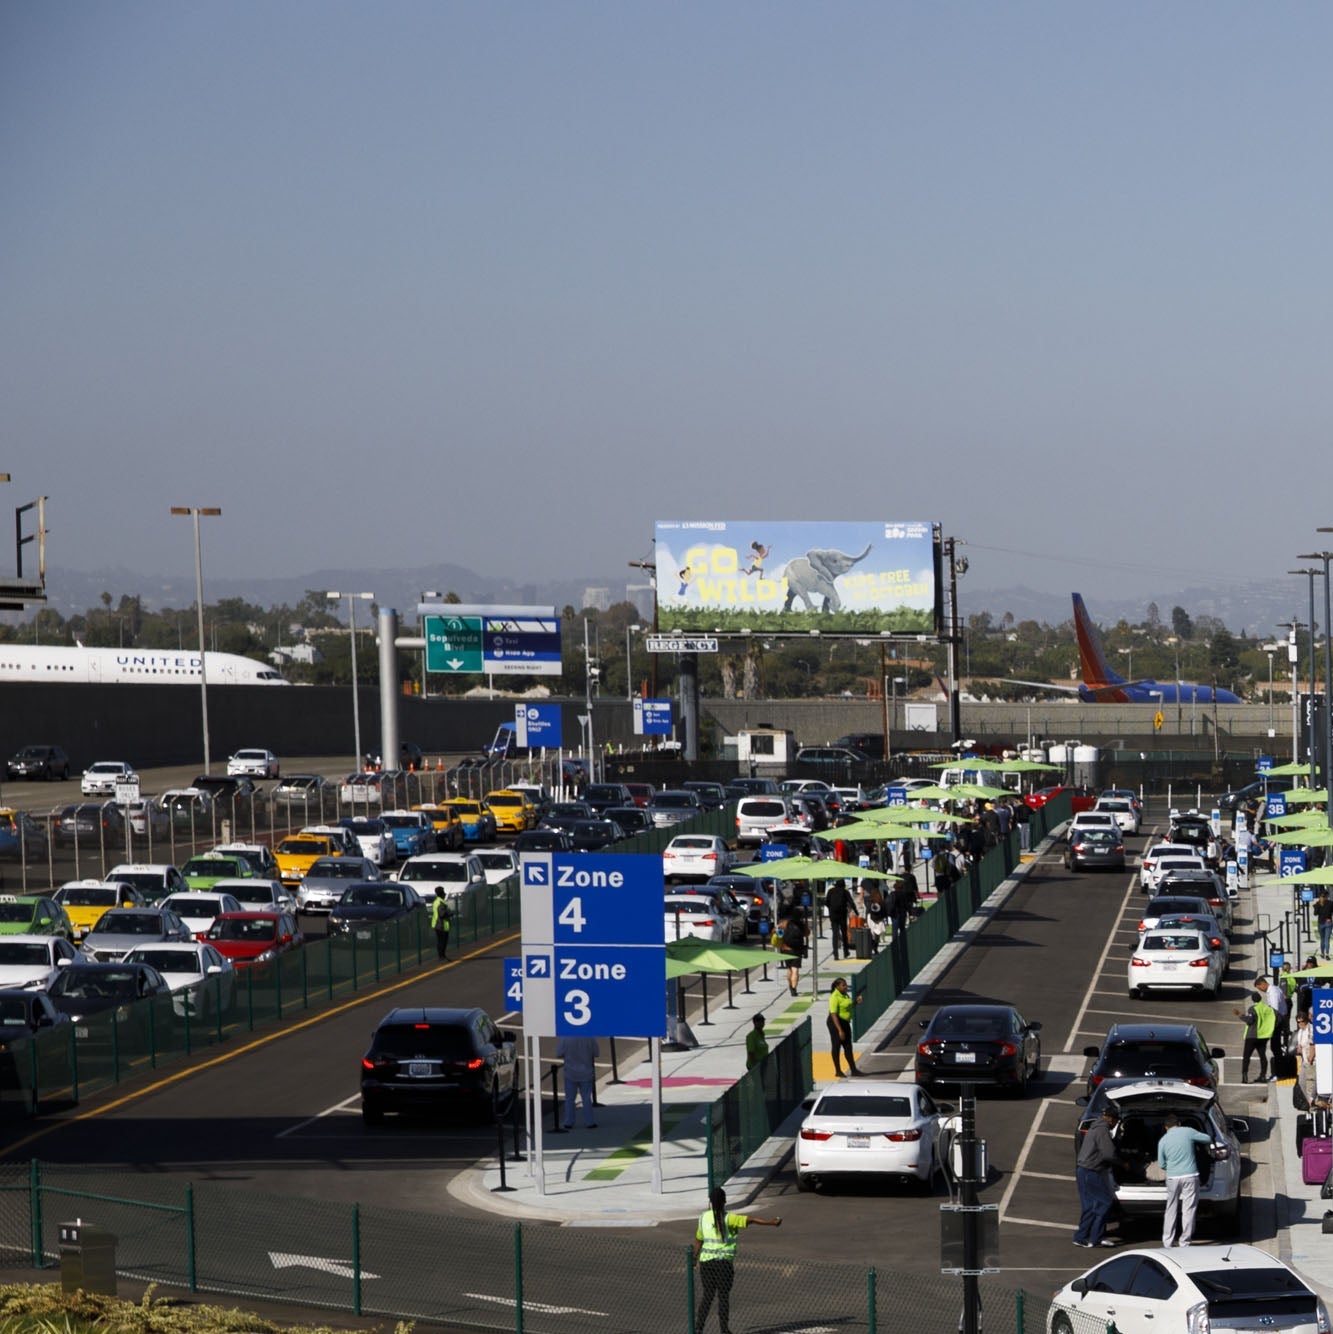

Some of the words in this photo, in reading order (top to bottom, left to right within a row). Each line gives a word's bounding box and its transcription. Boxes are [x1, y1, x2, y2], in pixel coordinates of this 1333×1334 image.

[686, 547, 738, 574] GO
[879, 569, 911, 585] FREE
[697, 577, 789, 603] WILD!
[430, 634, 478, 643] Sepulveda
[649, 641, 715, 651] REGENCY
[444, 643, 465, 651] Blvd
[117, 656, 203, 668] UNITED
[1269, 804, 1285, 814] 3B
[557, 866, 624, 887] Zone
[1282, 865, 1304, 878] 3C
[558, 897, 587, 933] 4
[559, 958, 627, 980] Zone
[563, 989, 592, 1026] 3
